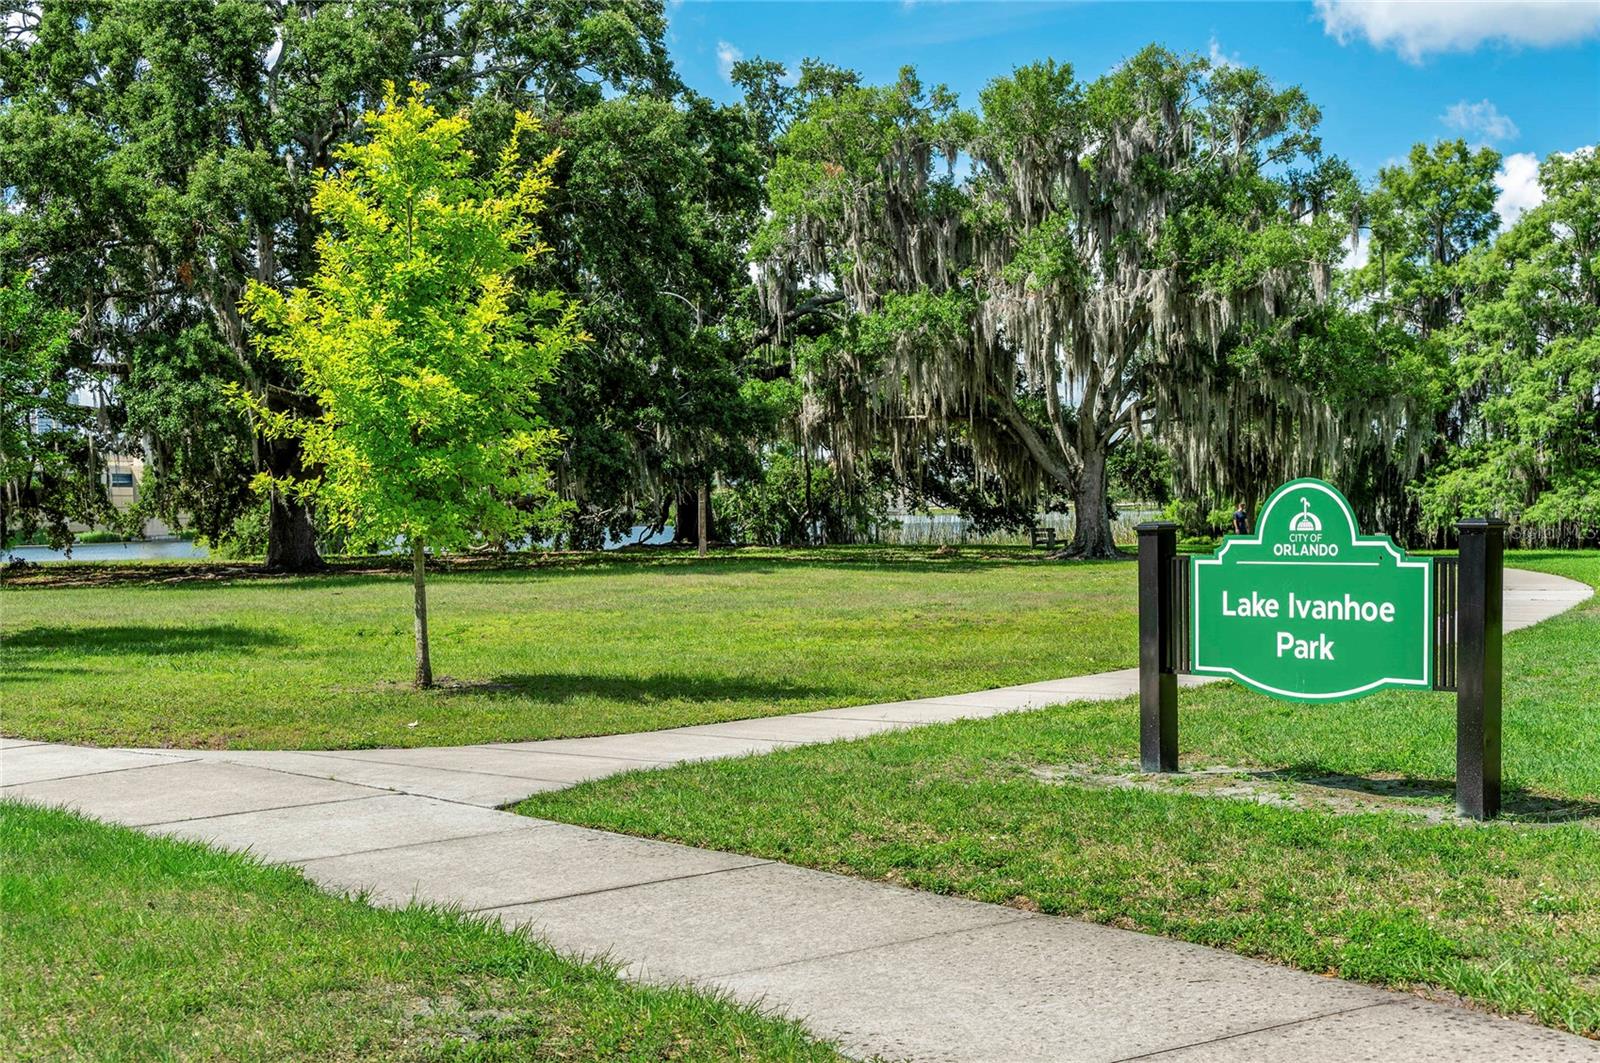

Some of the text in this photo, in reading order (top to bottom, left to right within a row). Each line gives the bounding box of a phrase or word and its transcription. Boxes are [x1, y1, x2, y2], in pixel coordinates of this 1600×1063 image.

[1289, 533, 1323, 543] CITY OF
[1273, 543, 1339, 556] ORLANDO
[1222, 591, 1395, 623] Lake Ivanhoe
[1276, 631, 1335, 660] Park
